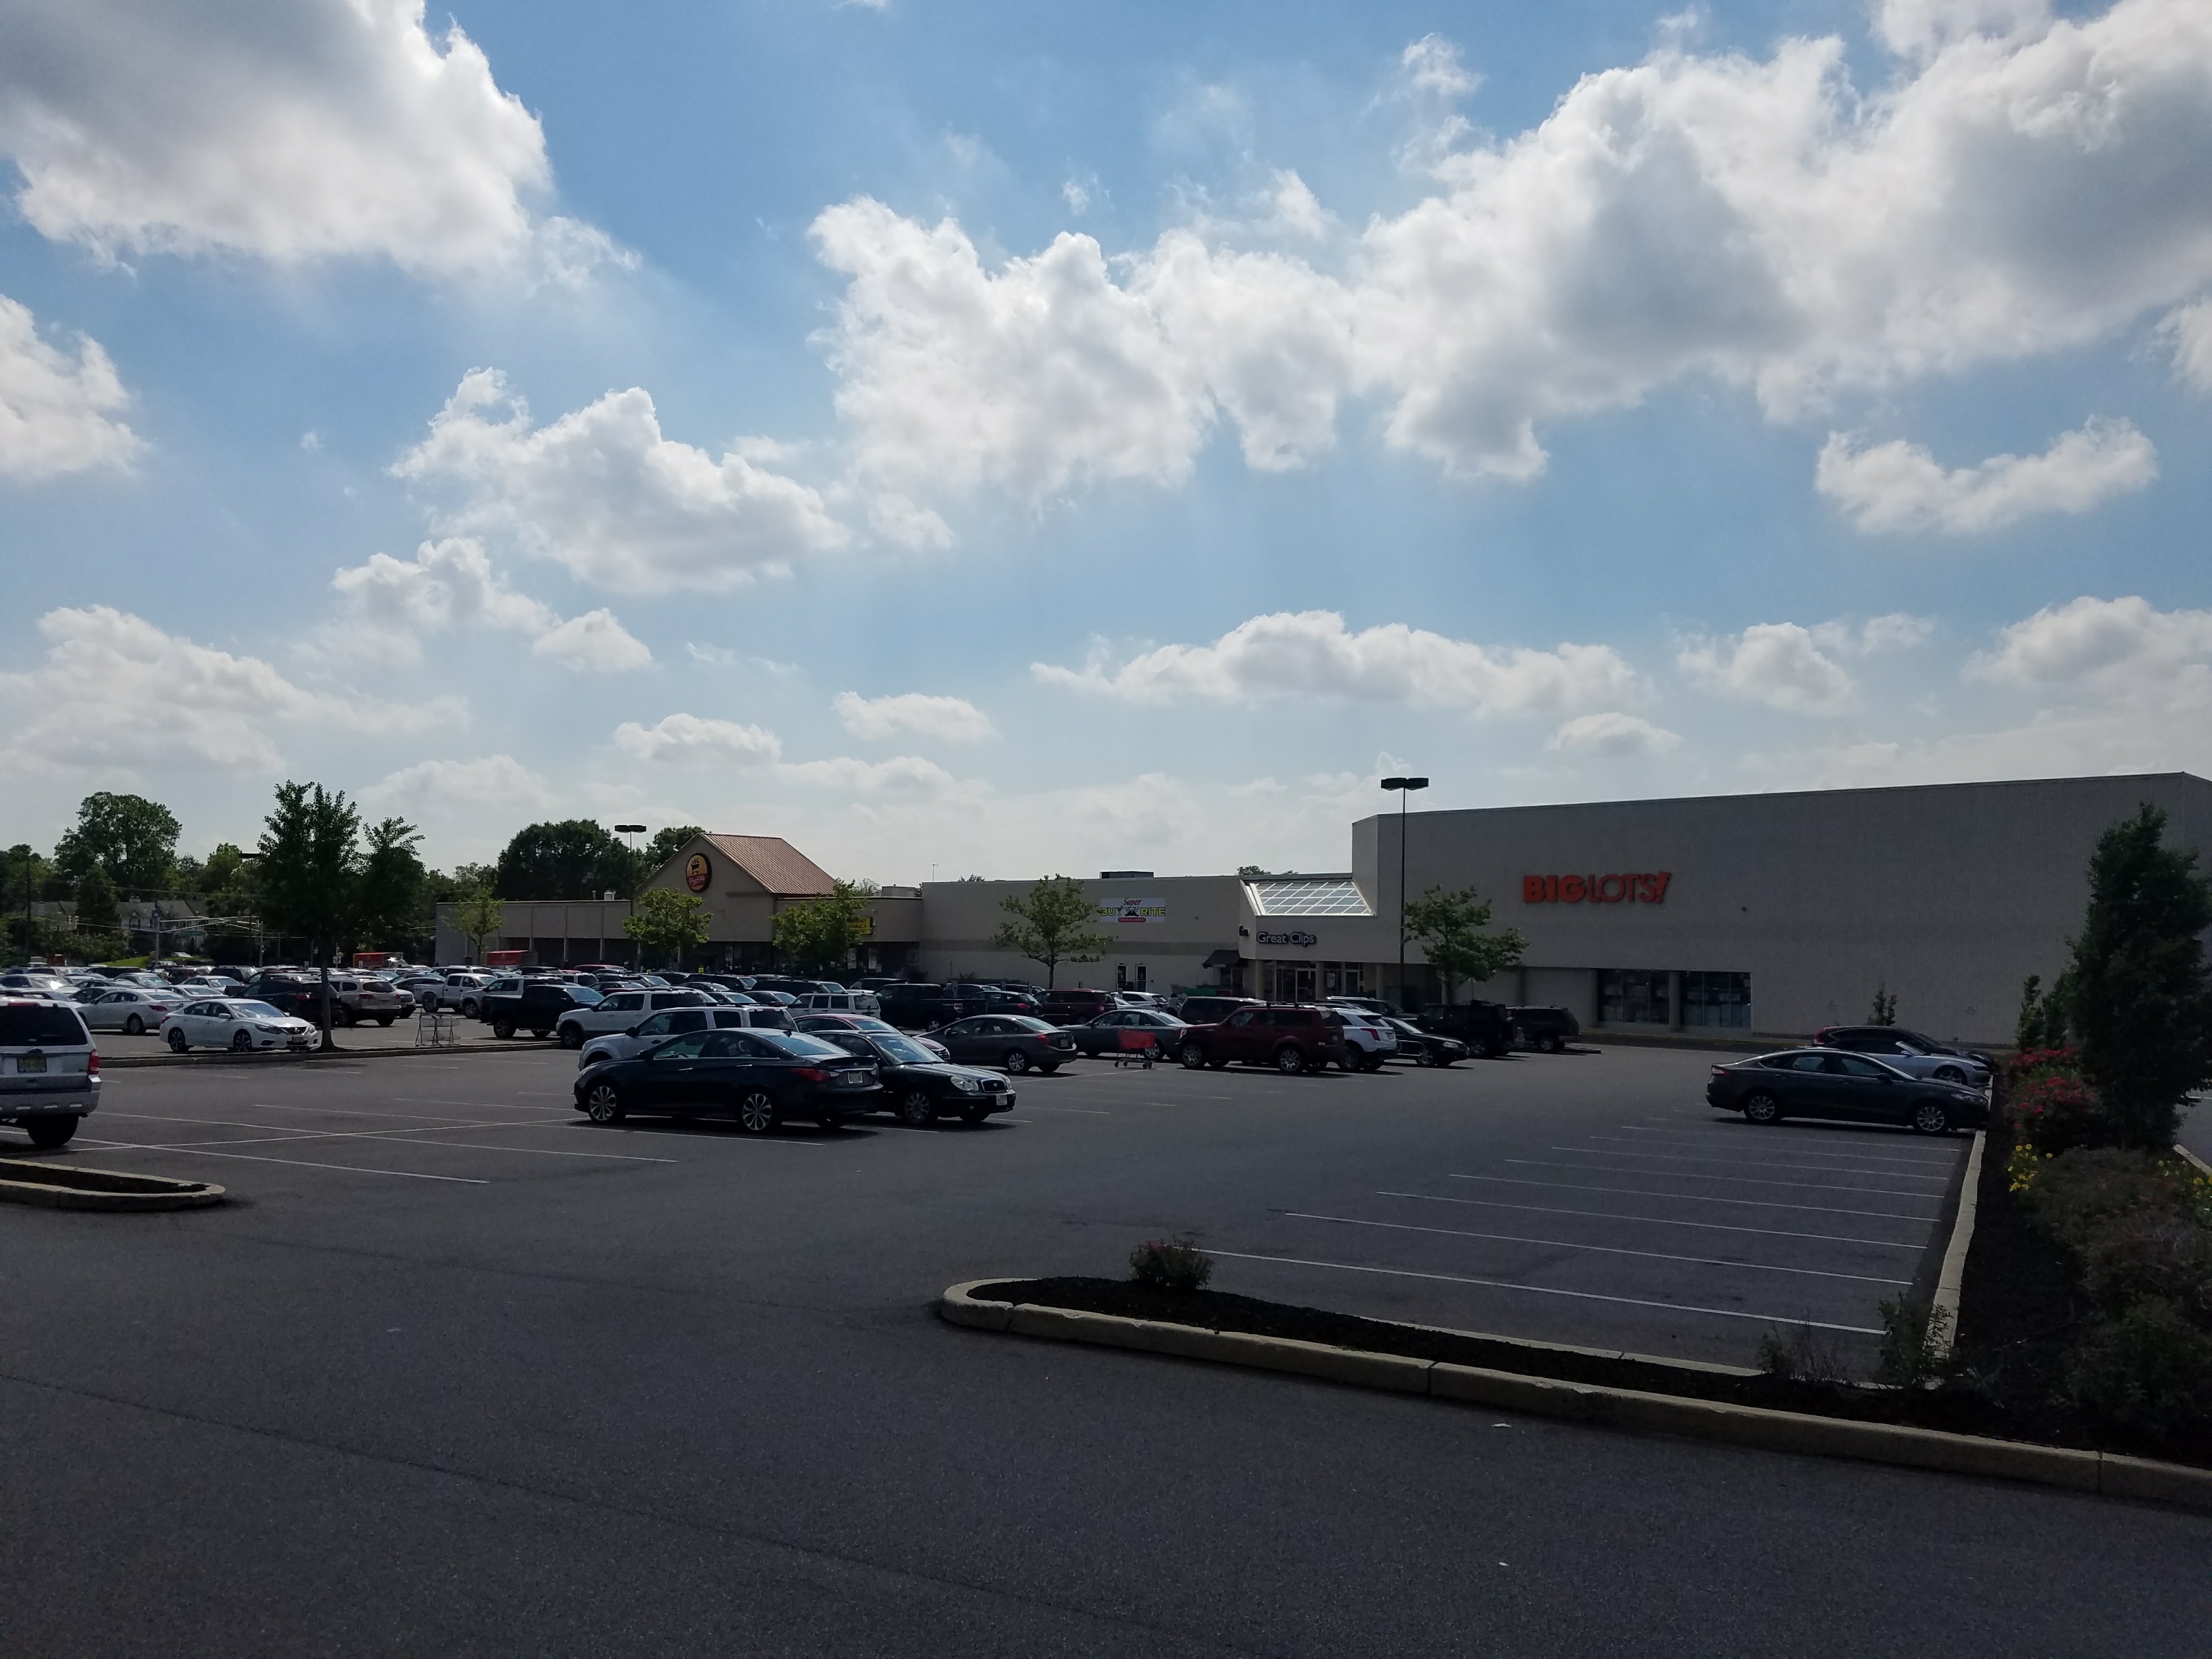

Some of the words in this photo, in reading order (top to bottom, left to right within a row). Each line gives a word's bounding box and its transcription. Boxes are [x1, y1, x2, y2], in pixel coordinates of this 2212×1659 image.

[1123, 898, 1143, 906] Super
[1140, 907, 1166, 917] RITE
[1257, 931, 1288, 944] Great
[1289, 931, 1317, 947] Clips
